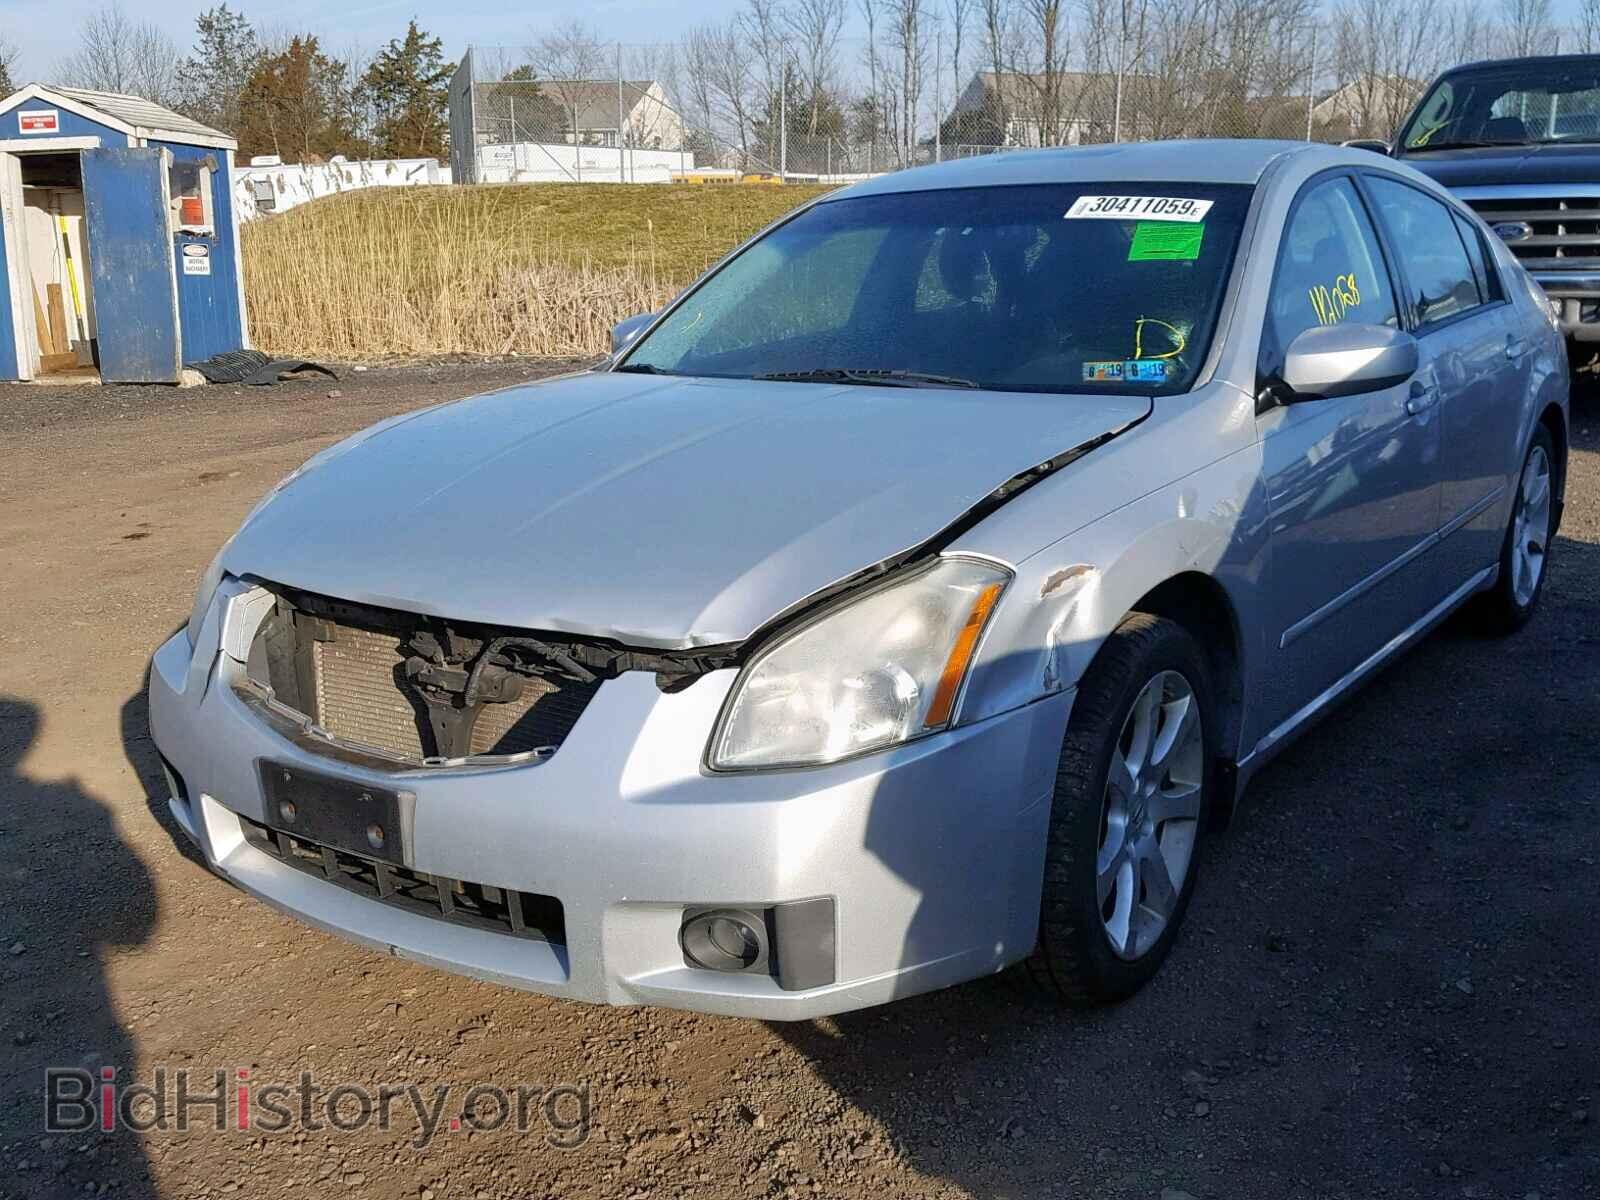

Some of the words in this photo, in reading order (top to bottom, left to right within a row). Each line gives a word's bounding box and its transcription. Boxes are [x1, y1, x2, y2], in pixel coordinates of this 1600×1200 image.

[1089, 197, 1195, 214] 30411059
[1110, 364, 1122, 376] 19
[1152, 364, 1165, 376] 19
